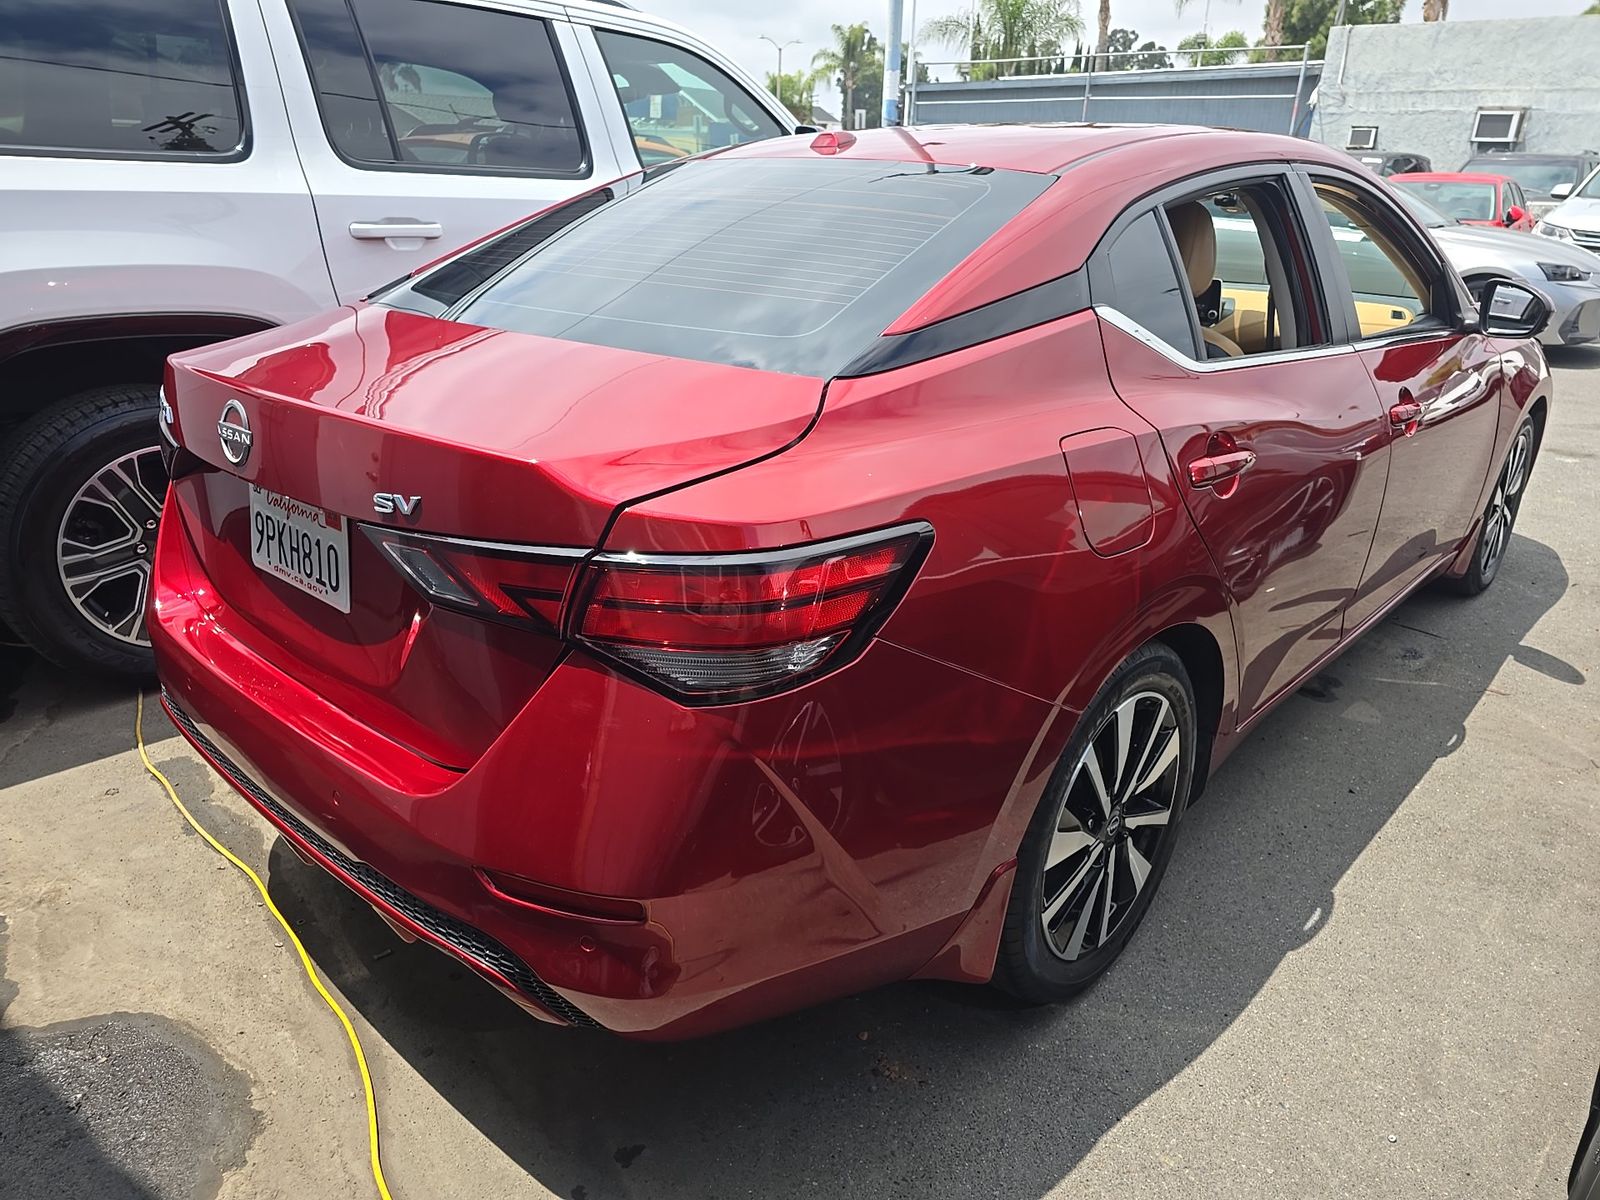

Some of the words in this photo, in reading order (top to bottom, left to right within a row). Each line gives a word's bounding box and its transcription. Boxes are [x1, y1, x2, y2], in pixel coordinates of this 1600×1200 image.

[217, 424, 251, 445] SSAN
[373, 493, 421, 515] SV
[255, 510, 340, 593] 9PKH810
[274, 565, 323, 594] dmv.ca.gov
